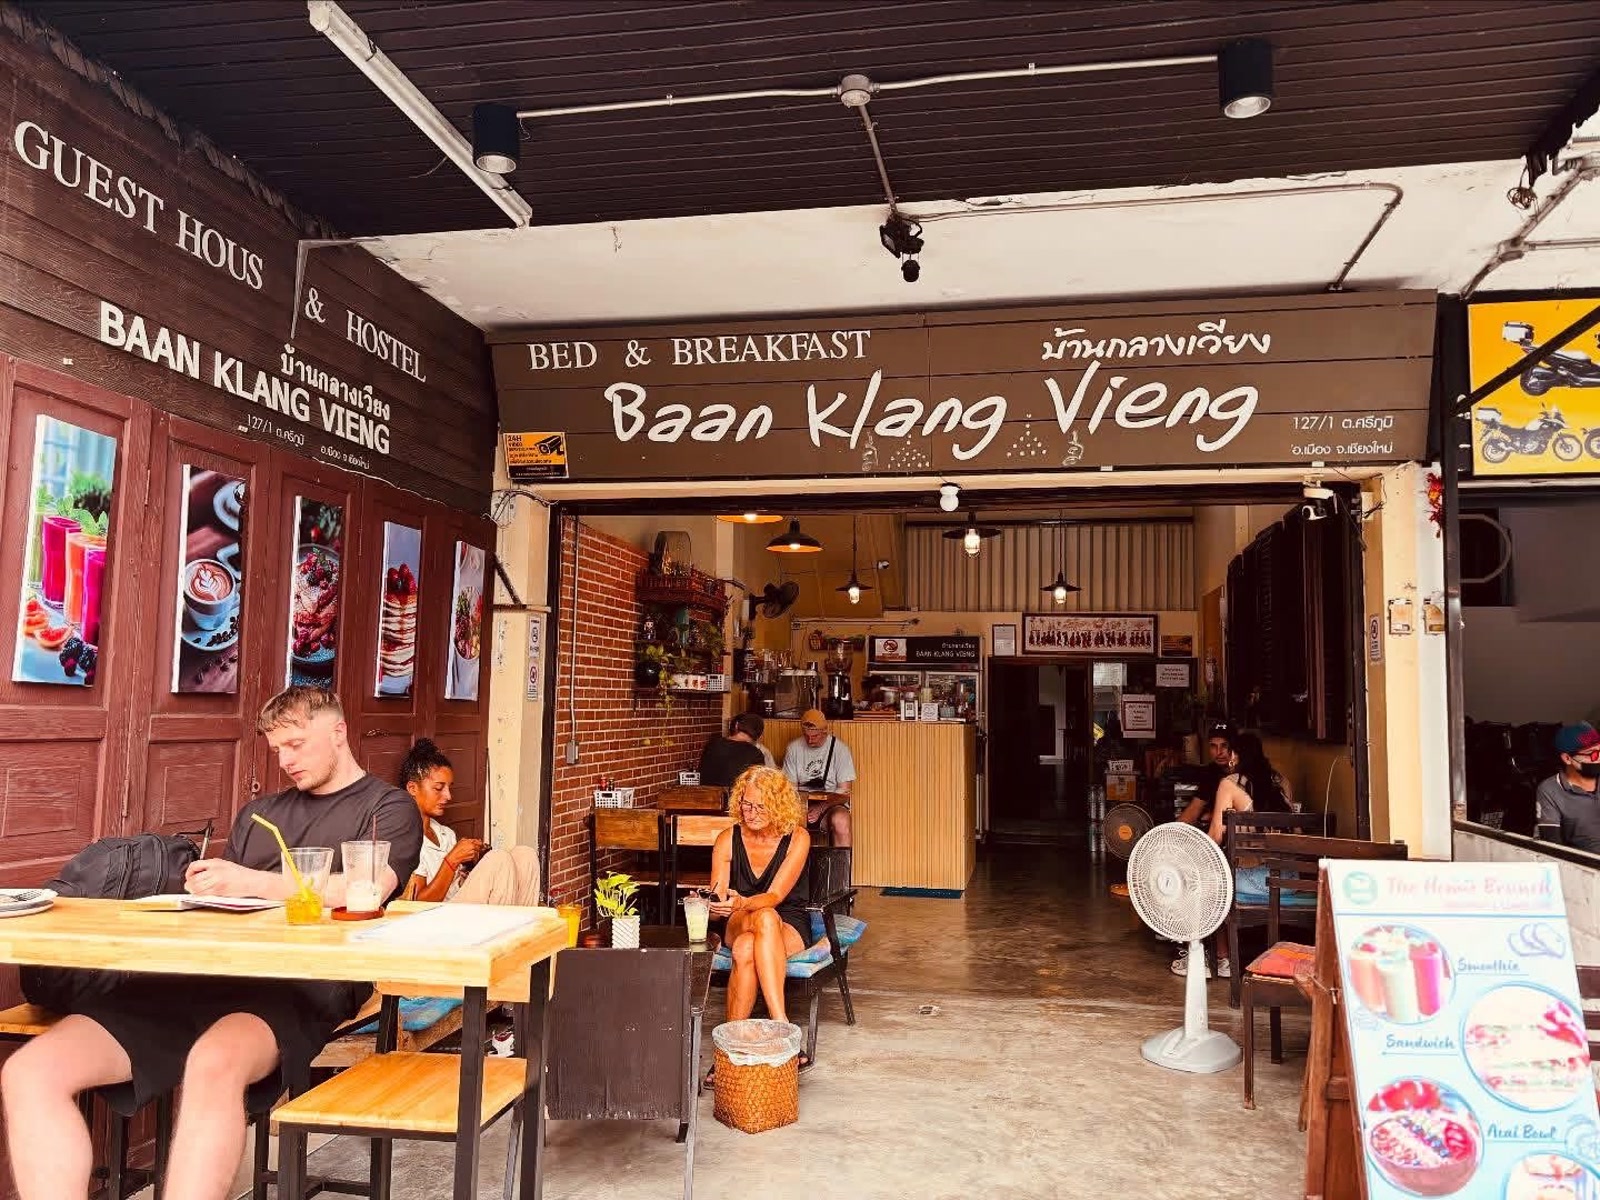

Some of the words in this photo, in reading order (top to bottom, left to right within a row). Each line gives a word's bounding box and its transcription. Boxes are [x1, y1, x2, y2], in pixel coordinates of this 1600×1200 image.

[14, 121, 164, 234] GUEST
[175, 209, 265, 290] HOUS
[304, 287, 326, 323] &
[346, 309, 427, 383] HOSTEL
[527, 340, 598, 371] BED
[624, 339, 652, 368] &
[671, 330, 871, 366] BREAKFAST
[1041, 319, 1271, 361] บ้านกลางเวียง
[100, 300, 201, 379] BAAN
[213, 350, 311, 423] KLANG
[318, 398, 391, 455] VIENG
[281, 343, 391, 421] บ้านกลางเวียง
[247, 413, 273, 434] 127/1
[604, 382, 773, 443] Baan
[806, 368, 1008, 461] Klang
[1044, 361, 1260, 453] Vieng
[1293, 415, 1334, 431] 127/1
[1341, 415, 1394, 432] ต.ศรีภูมิ
[1457, 957, 1520, 972] Smoothie
[1386, 1034, 1457, 1050] Sandwich
[1523, 1124, 1558, 1139] Bowl
